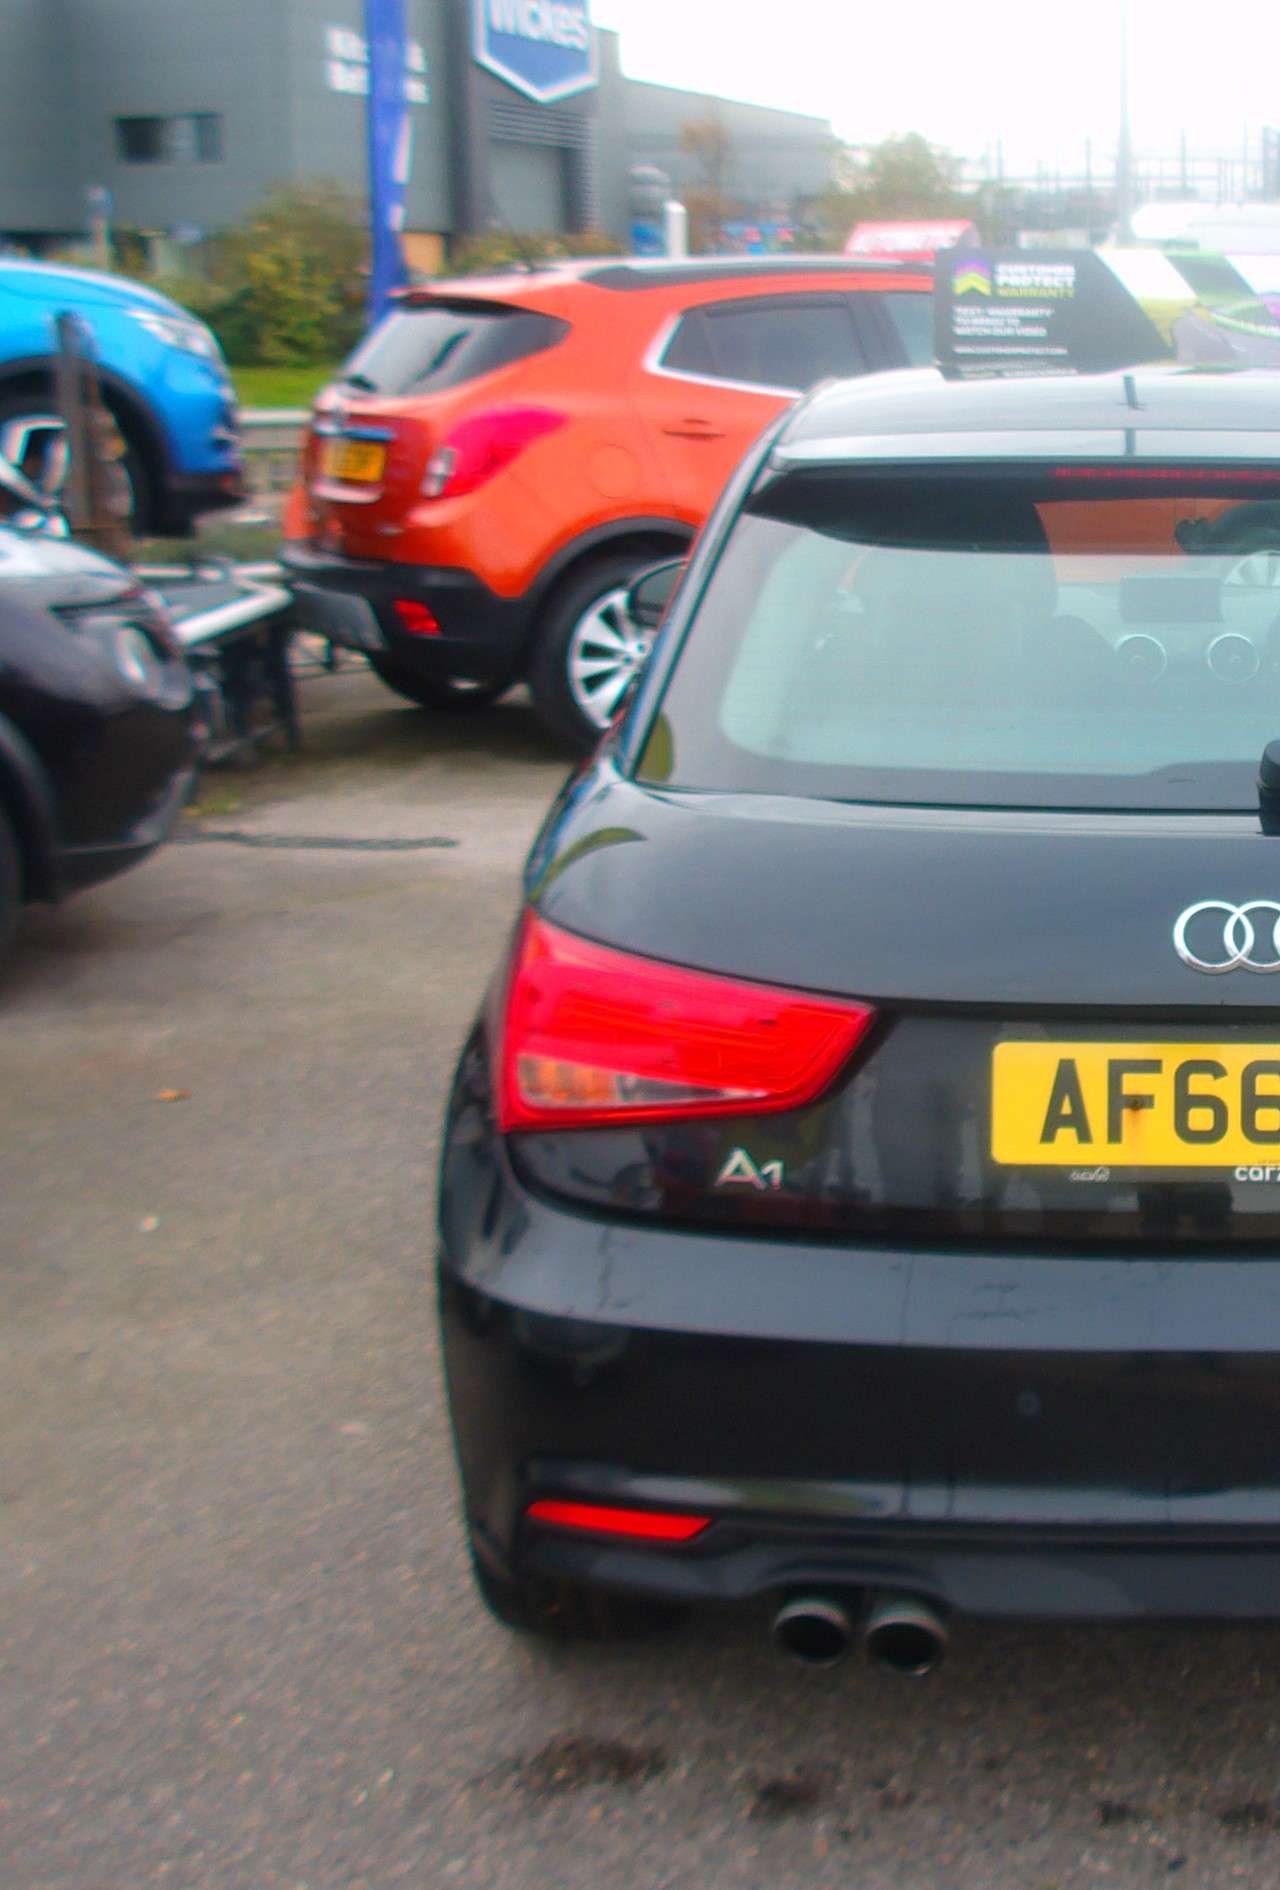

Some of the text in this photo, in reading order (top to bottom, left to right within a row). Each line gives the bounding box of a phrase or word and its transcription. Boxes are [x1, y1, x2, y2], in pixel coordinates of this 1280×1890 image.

[996, 263, 1076, 275] CUSTOMER
[996, 275, 1076, 288] PROTECT
[997, 287, 1076, 298] WARRANTY
[714, 1147, 784, 1190] A1
